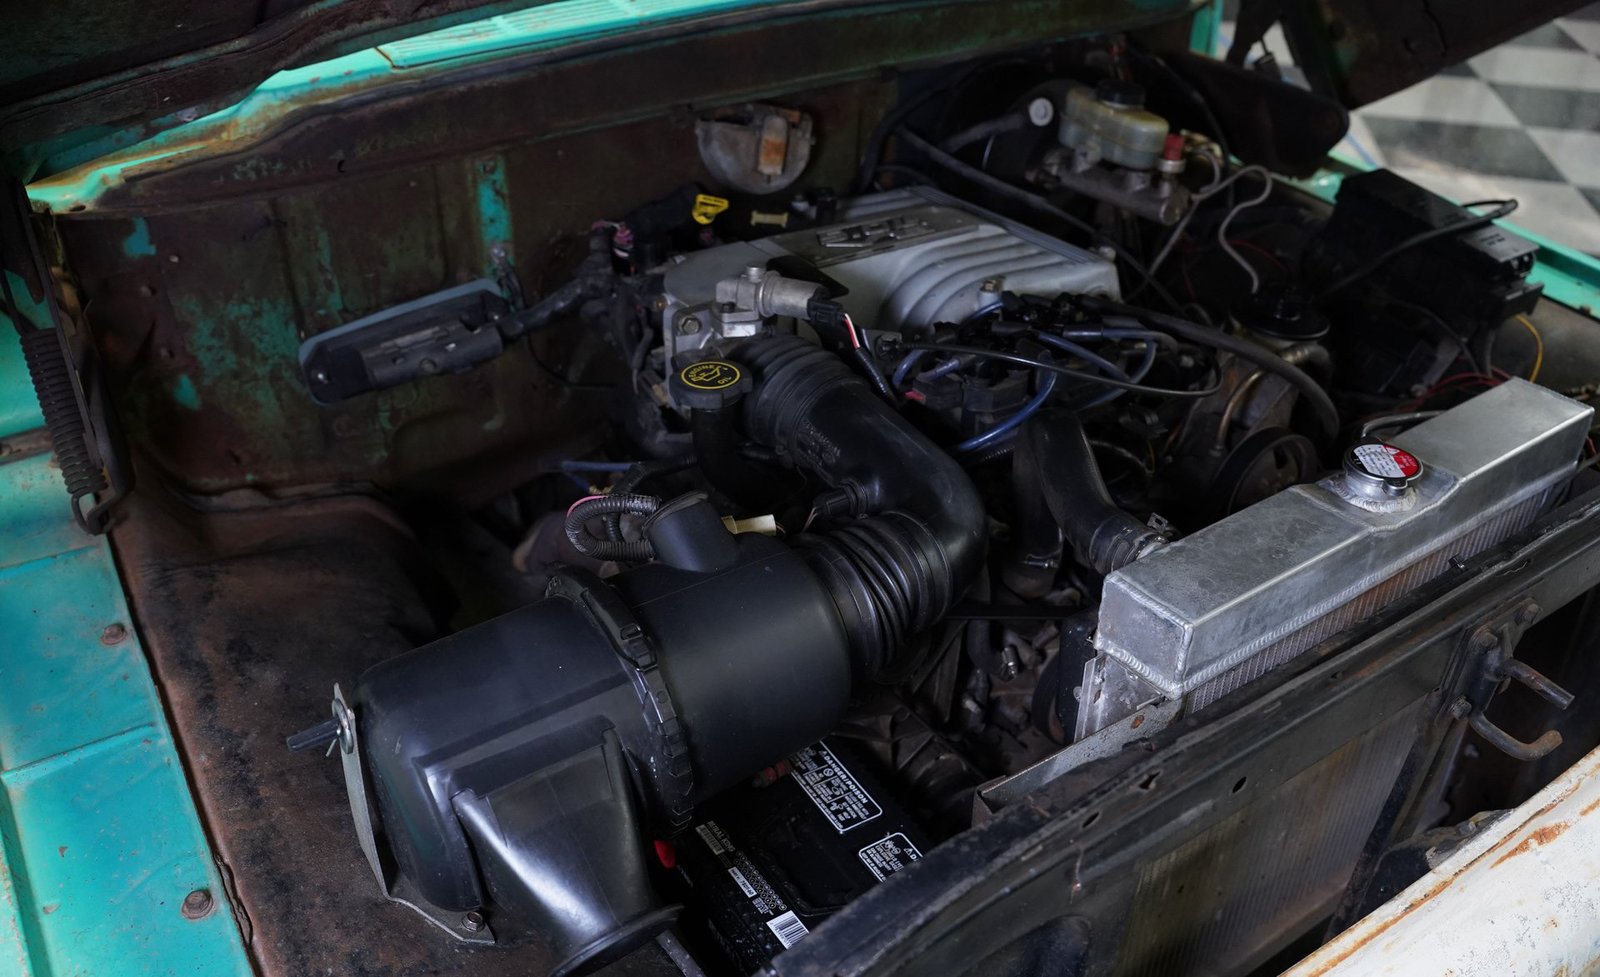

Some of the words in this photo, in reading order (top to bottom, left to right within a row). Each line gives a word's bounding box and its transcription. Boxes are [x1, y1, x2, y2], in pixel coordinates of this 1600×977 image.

[688, 364, 715, 378] ENGINE
[717, 376, 732, 384] OIL
[824, 756, 868, 804] DANGER/POISON
